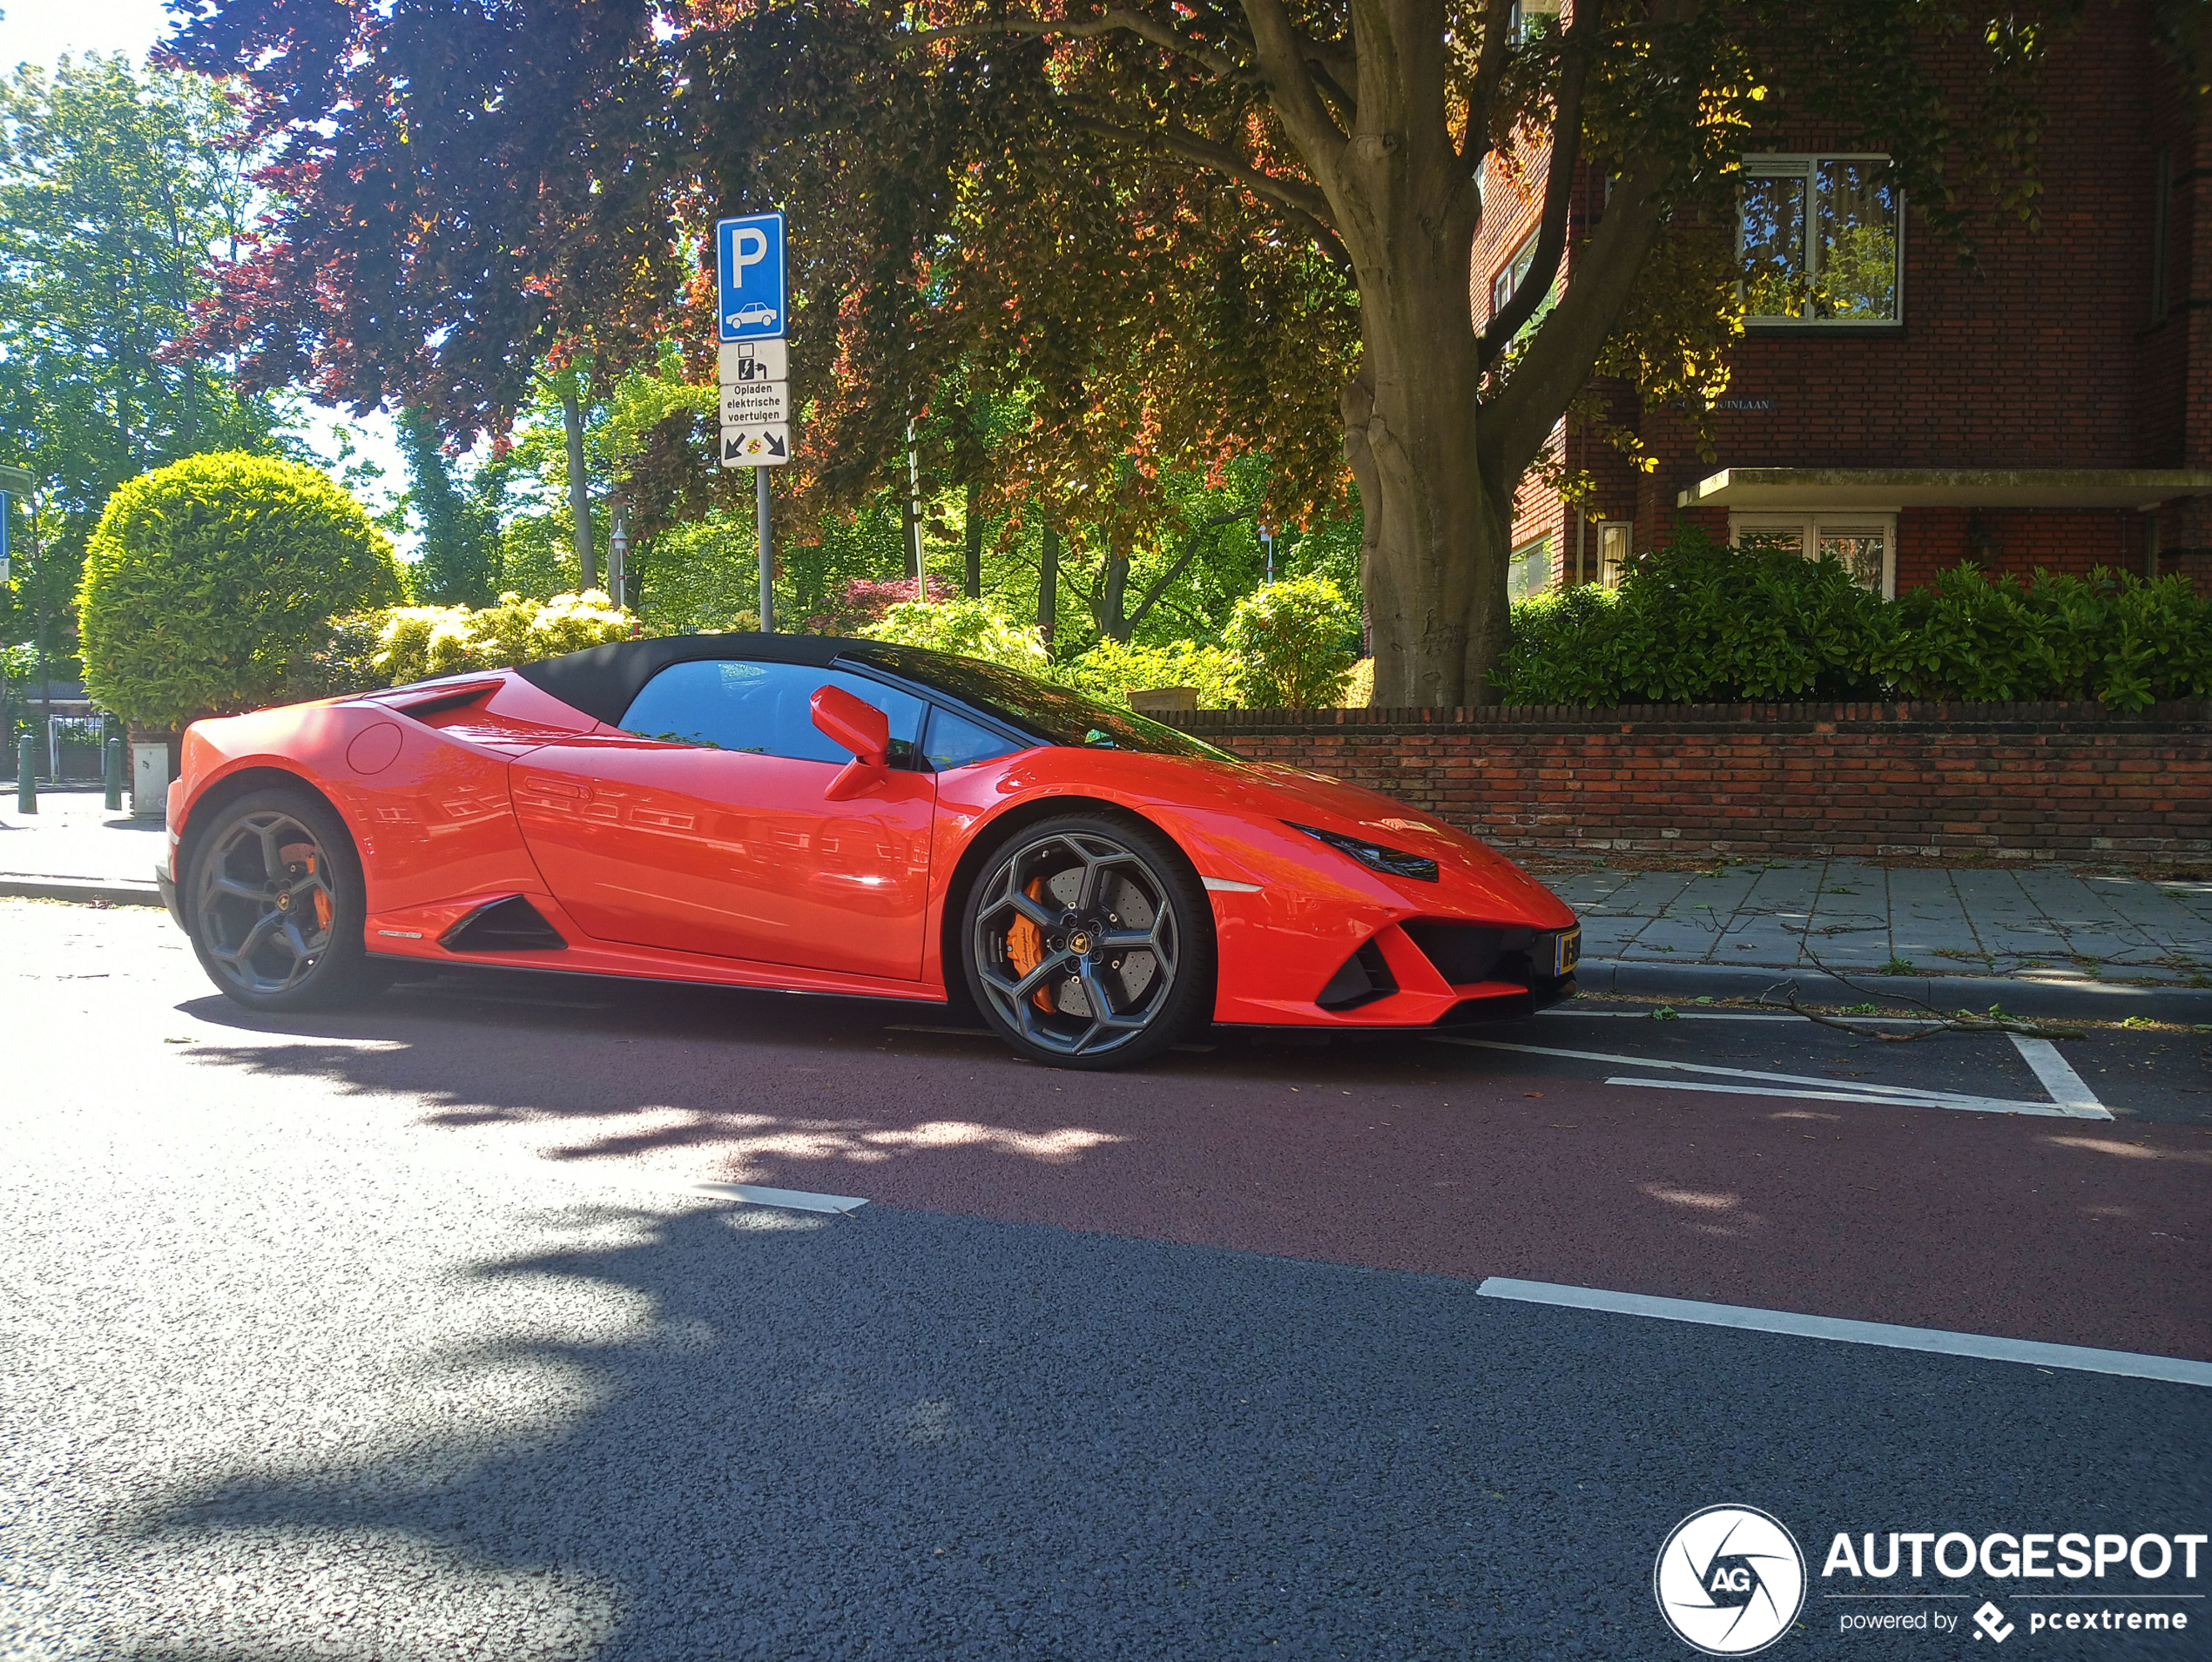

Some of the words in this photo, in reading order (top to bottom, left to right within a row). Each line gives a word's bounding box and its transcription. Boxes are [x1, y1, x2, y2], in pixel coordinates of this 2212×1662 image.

[732, 226, 768, 288] P
[734, 384, 772, 397] Opladen
[727, 396, 780, 408] elektrische
[728, 410, 779, 422] voertuigen
